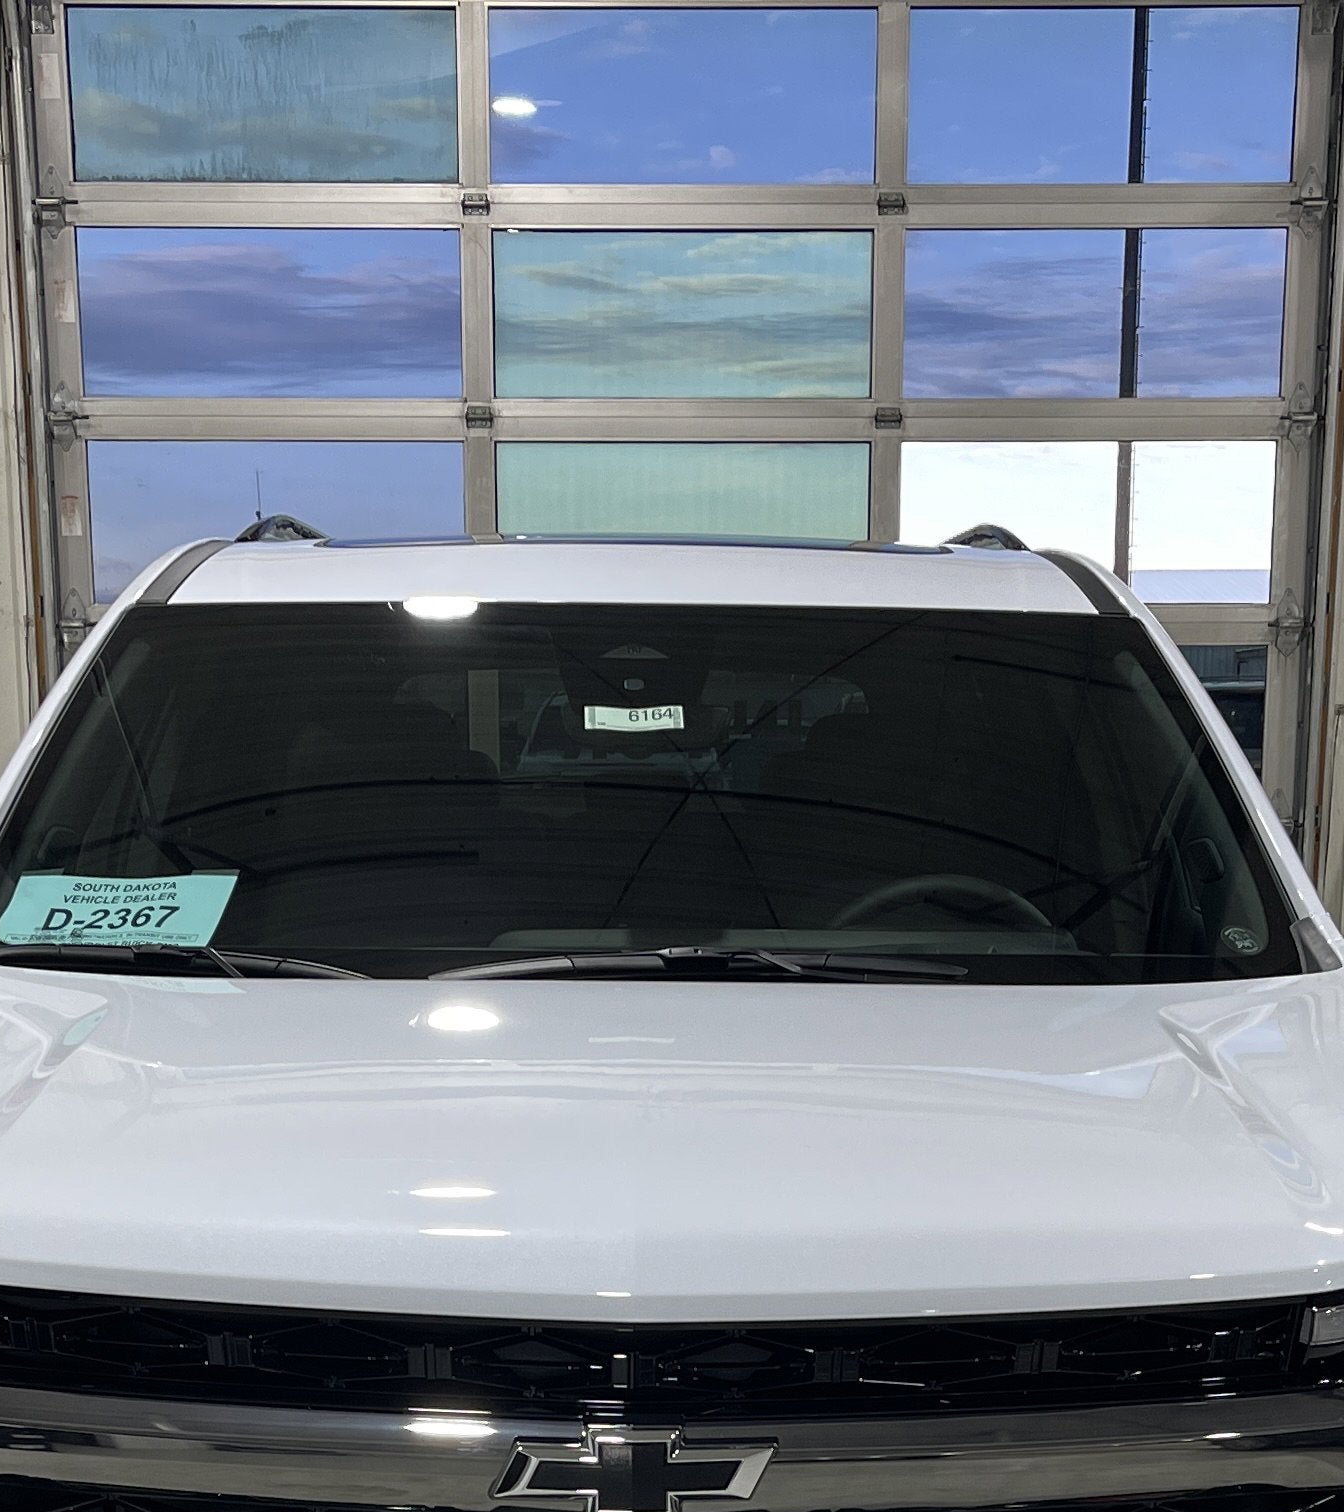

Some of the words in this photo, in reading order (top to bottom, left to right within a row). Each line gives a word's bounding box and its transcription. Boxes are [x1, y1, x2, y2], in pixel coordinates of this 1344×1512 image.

[628, 707, 674, 722] 6164
[72, 882, 121, 893] SOUTH
[123, 881, 177, 893] DAKOTA
[63, 894, 121, 904] VEHICLE
[123, 892, 177, 903] DEALER
[41, 905, 181, 931] D-2367
